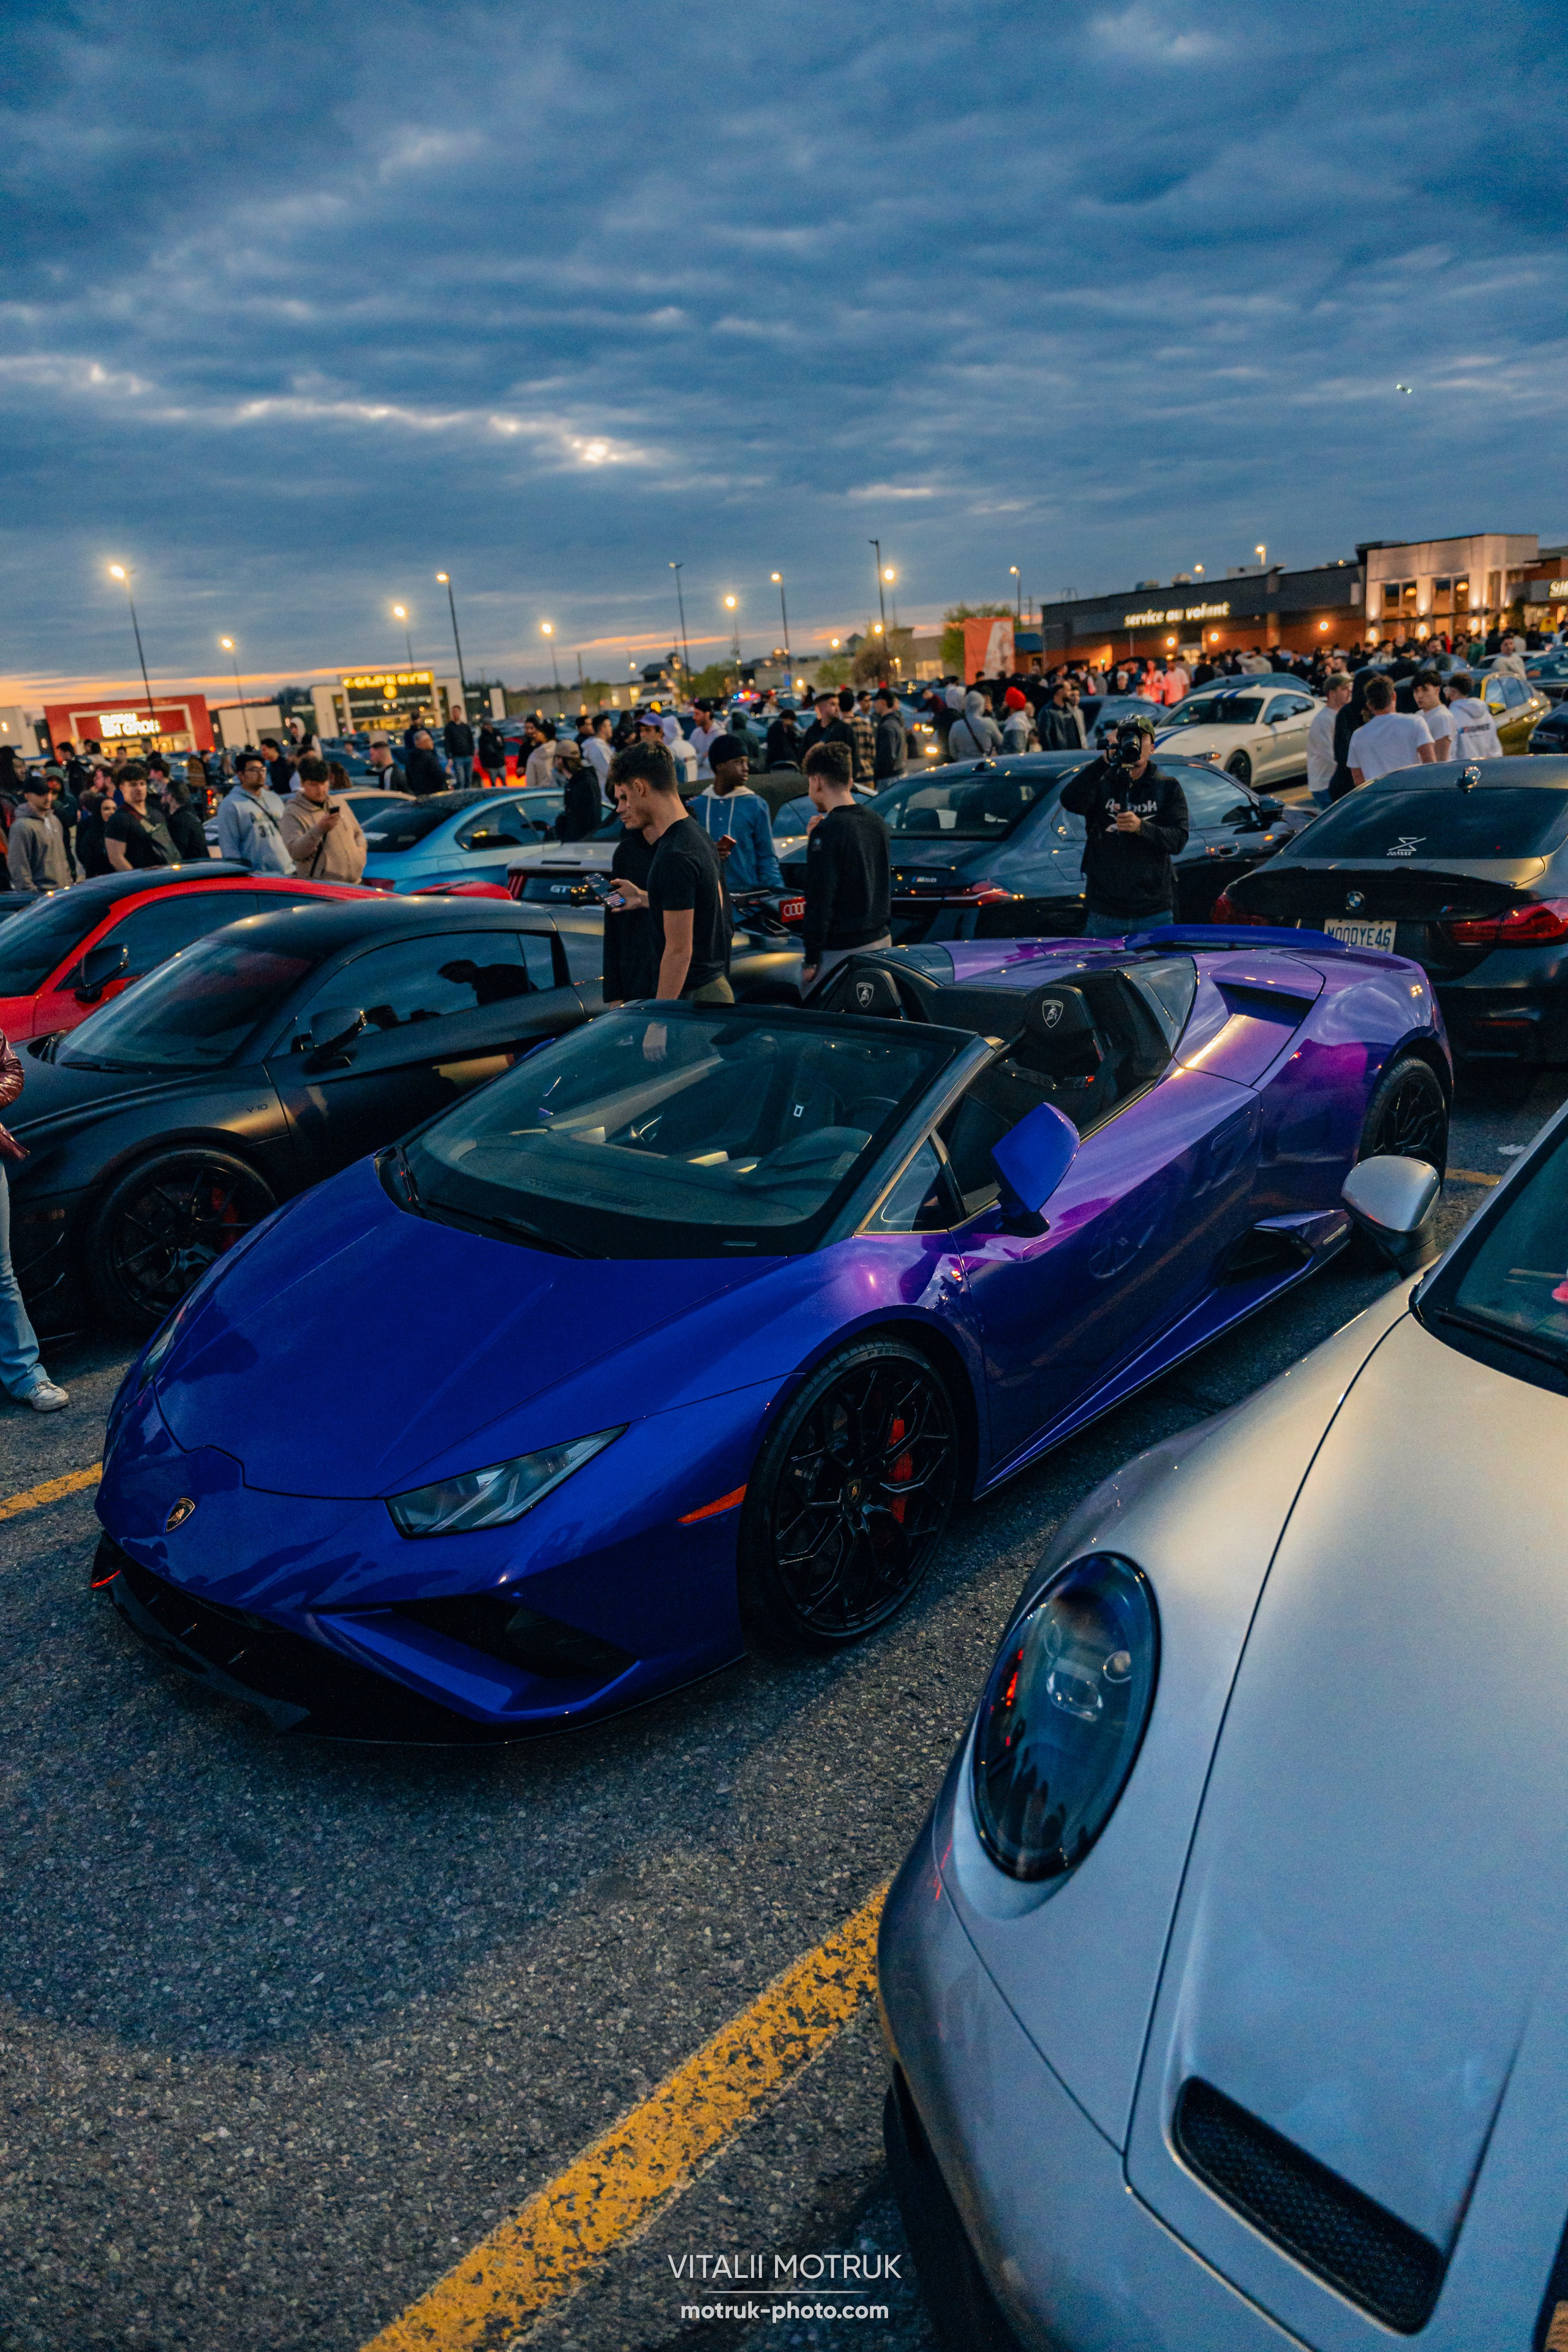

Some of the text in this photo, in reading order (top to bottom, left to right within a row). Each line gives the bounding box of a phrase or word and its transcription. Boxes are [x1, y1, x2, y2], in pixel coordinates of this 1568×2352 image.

[1124, 601, 1231, 627] service au volant
